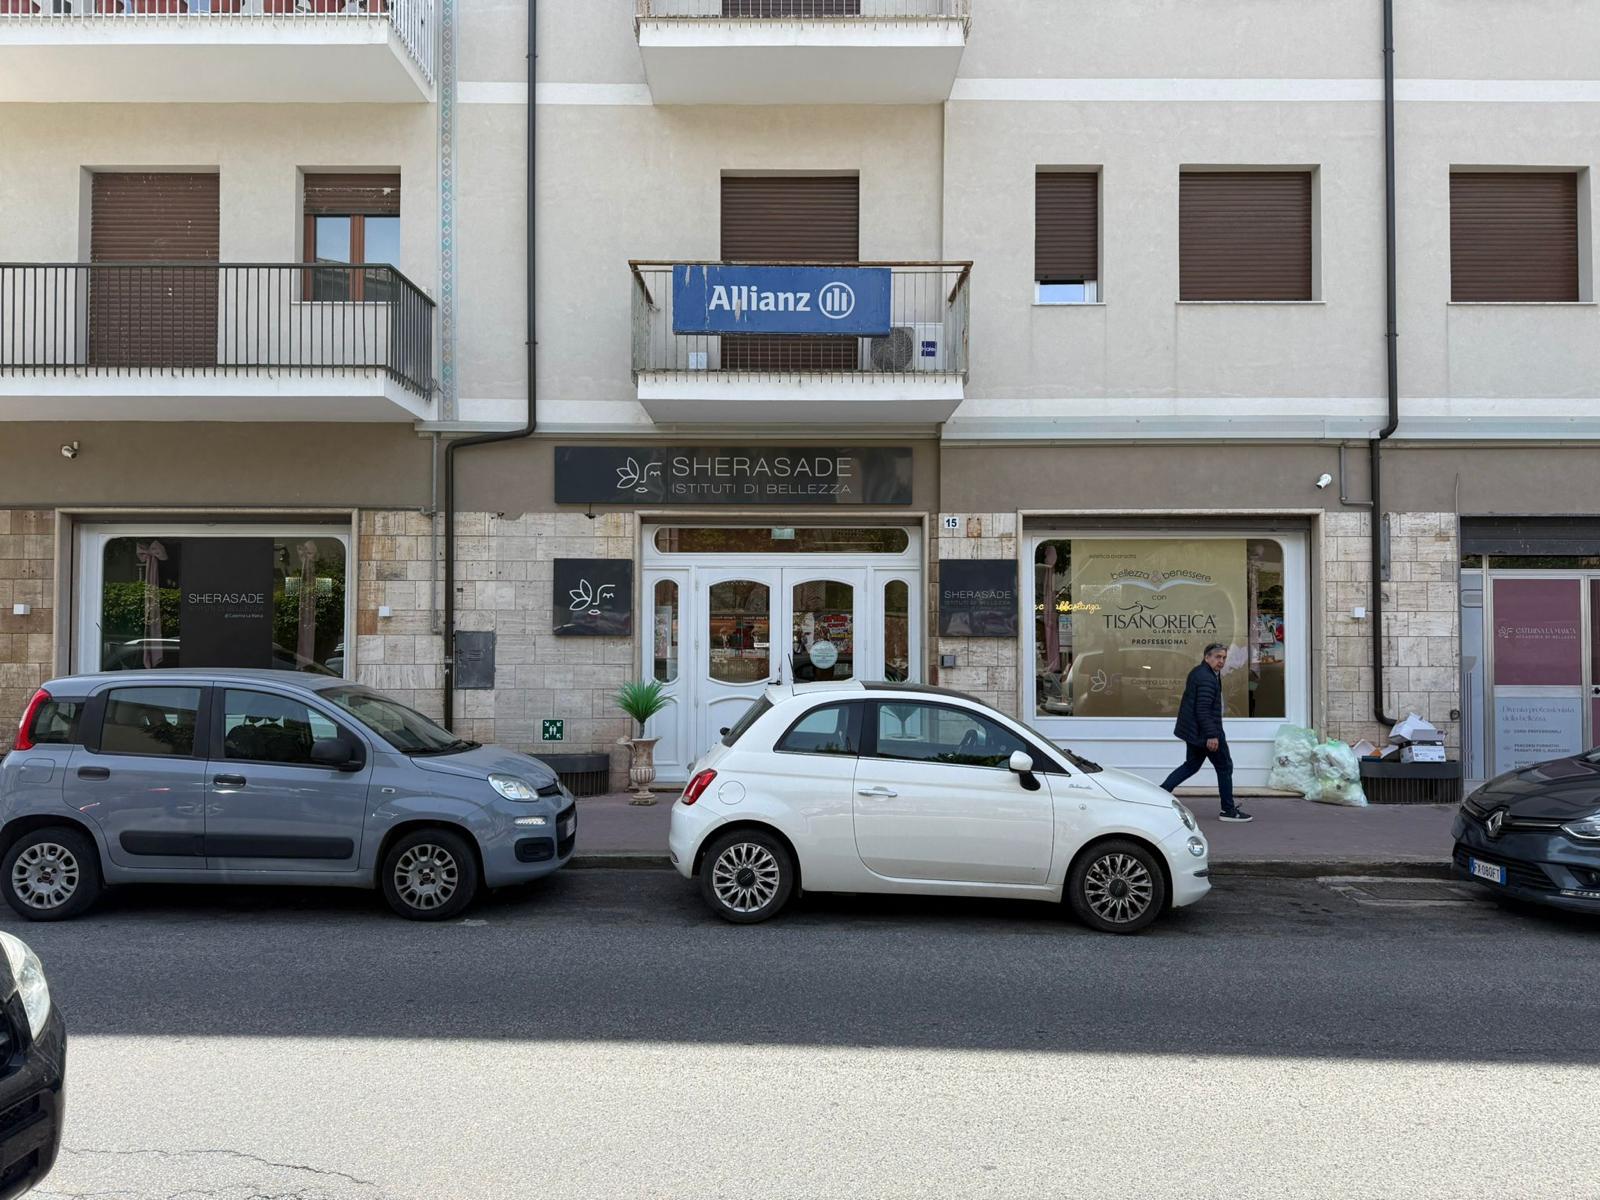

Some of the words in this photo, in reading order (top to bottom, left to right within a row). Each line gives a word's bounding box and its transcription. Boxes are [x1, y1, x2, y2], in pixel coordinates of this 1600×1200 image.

[709, 284, 811, 312] Allianz
[672, 457, 852, 477] SHERASADE
[672, 484, 737, 494] ISTITUTI
[744, 484, 759, 494] DI
[767, 484, 852, 494] BELLEZZA
[946, 519, 957, 527] 15
[1110, 568, 1150, 581] bellezza
[1162, 568, 1212, 583] benessere
[188, 593, 264, 604] SHERASADE
[944, 590, 1011, 599] SHERASADE
[1102, 613, 1217, 629] TISANOREICA
